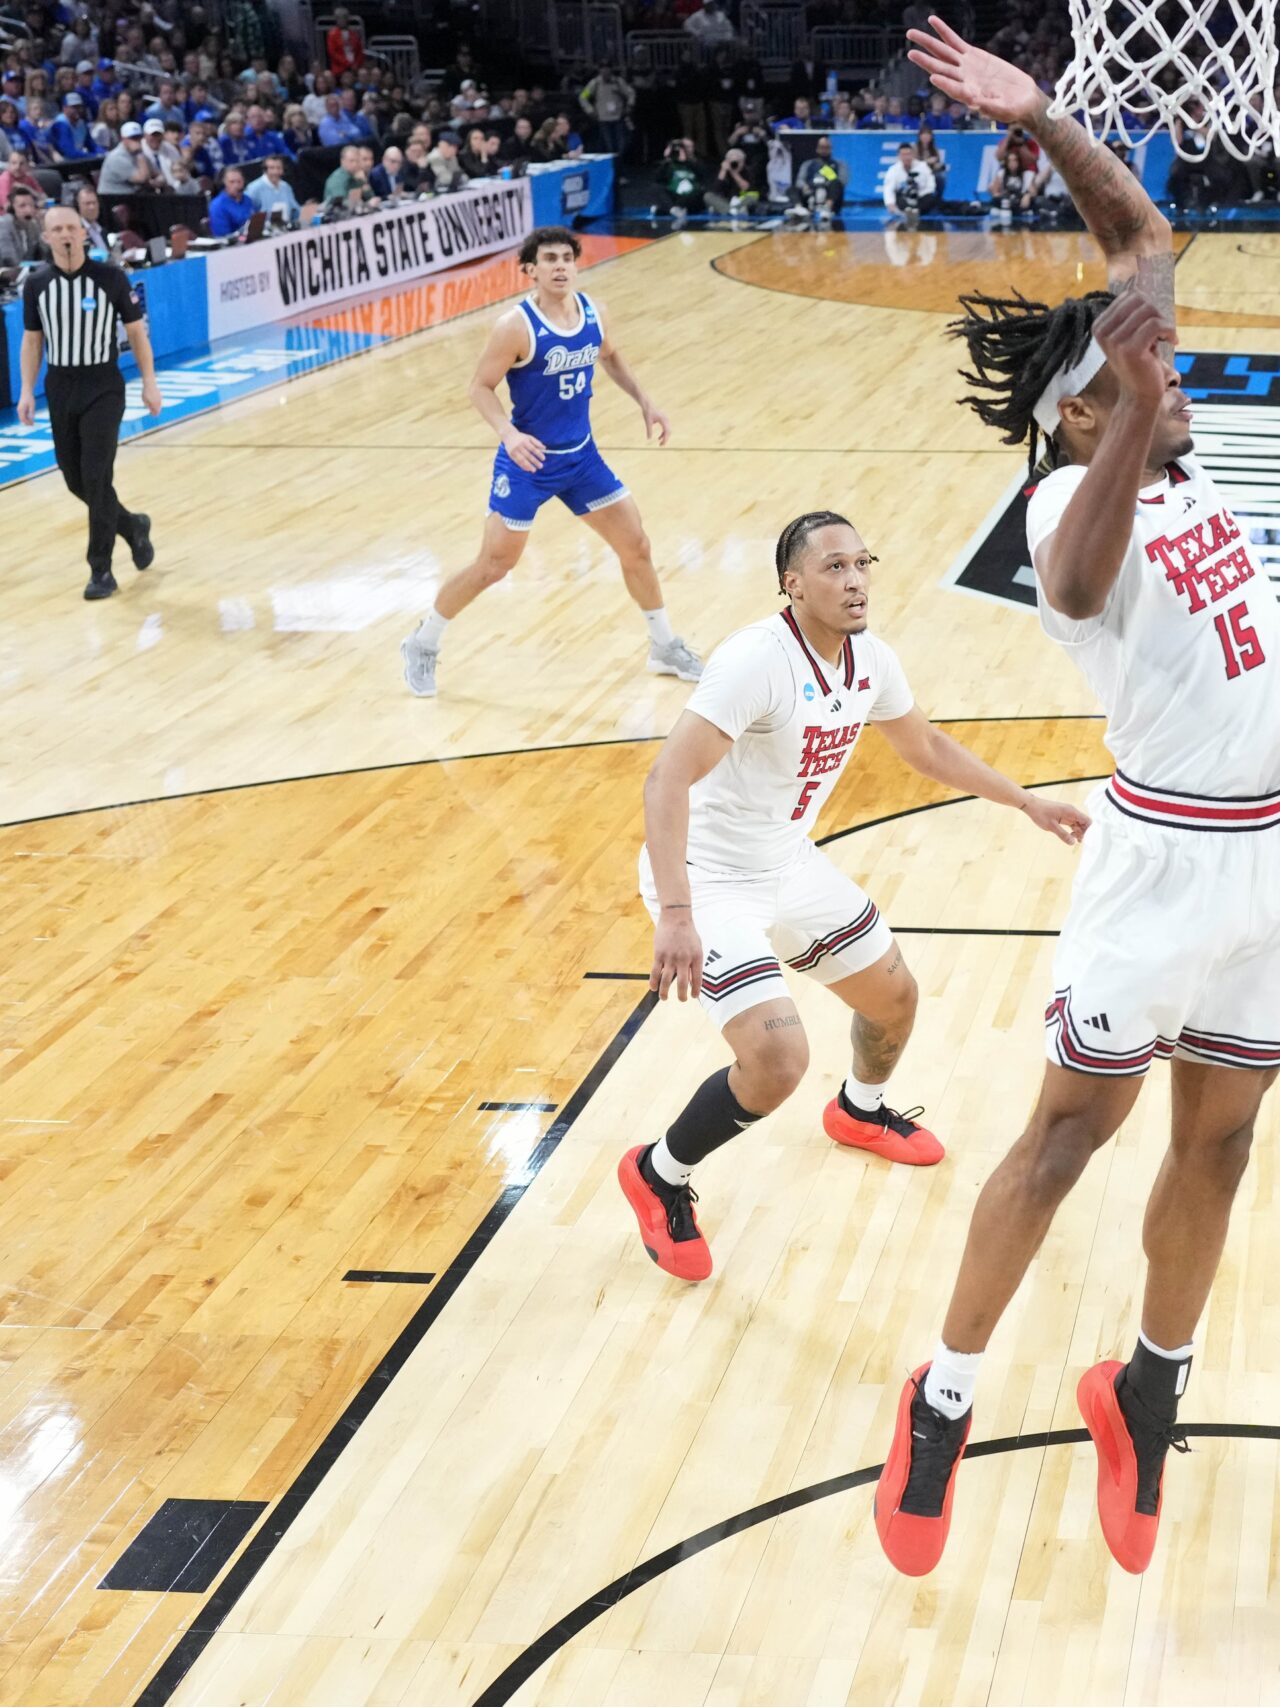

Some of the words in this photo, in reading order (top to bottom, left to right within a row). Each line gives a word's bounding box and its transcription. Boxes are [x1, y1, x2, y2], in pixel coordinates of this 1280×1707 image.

[220, 275, 257, 301] HOSTED
[258, 271, 270, 291] BY
[275, 228, 370, 306] WICHITA
[372, 211, 434, 277] STATE
[434, 188, 525, 258] UNIVERSITY
[542, 343, 600, 375] Drake
[558, 371, 586, 400] 54
[1145, 507, 1241, 581] TEXAS
[1173, 546, 1256, 615] TECH
[1214, 601, 1266, 680] 15
[802, 722, 861, 753] TEXAS
[796, 749, 846, 778] TECH
[790, 781, 821, 821] 5
